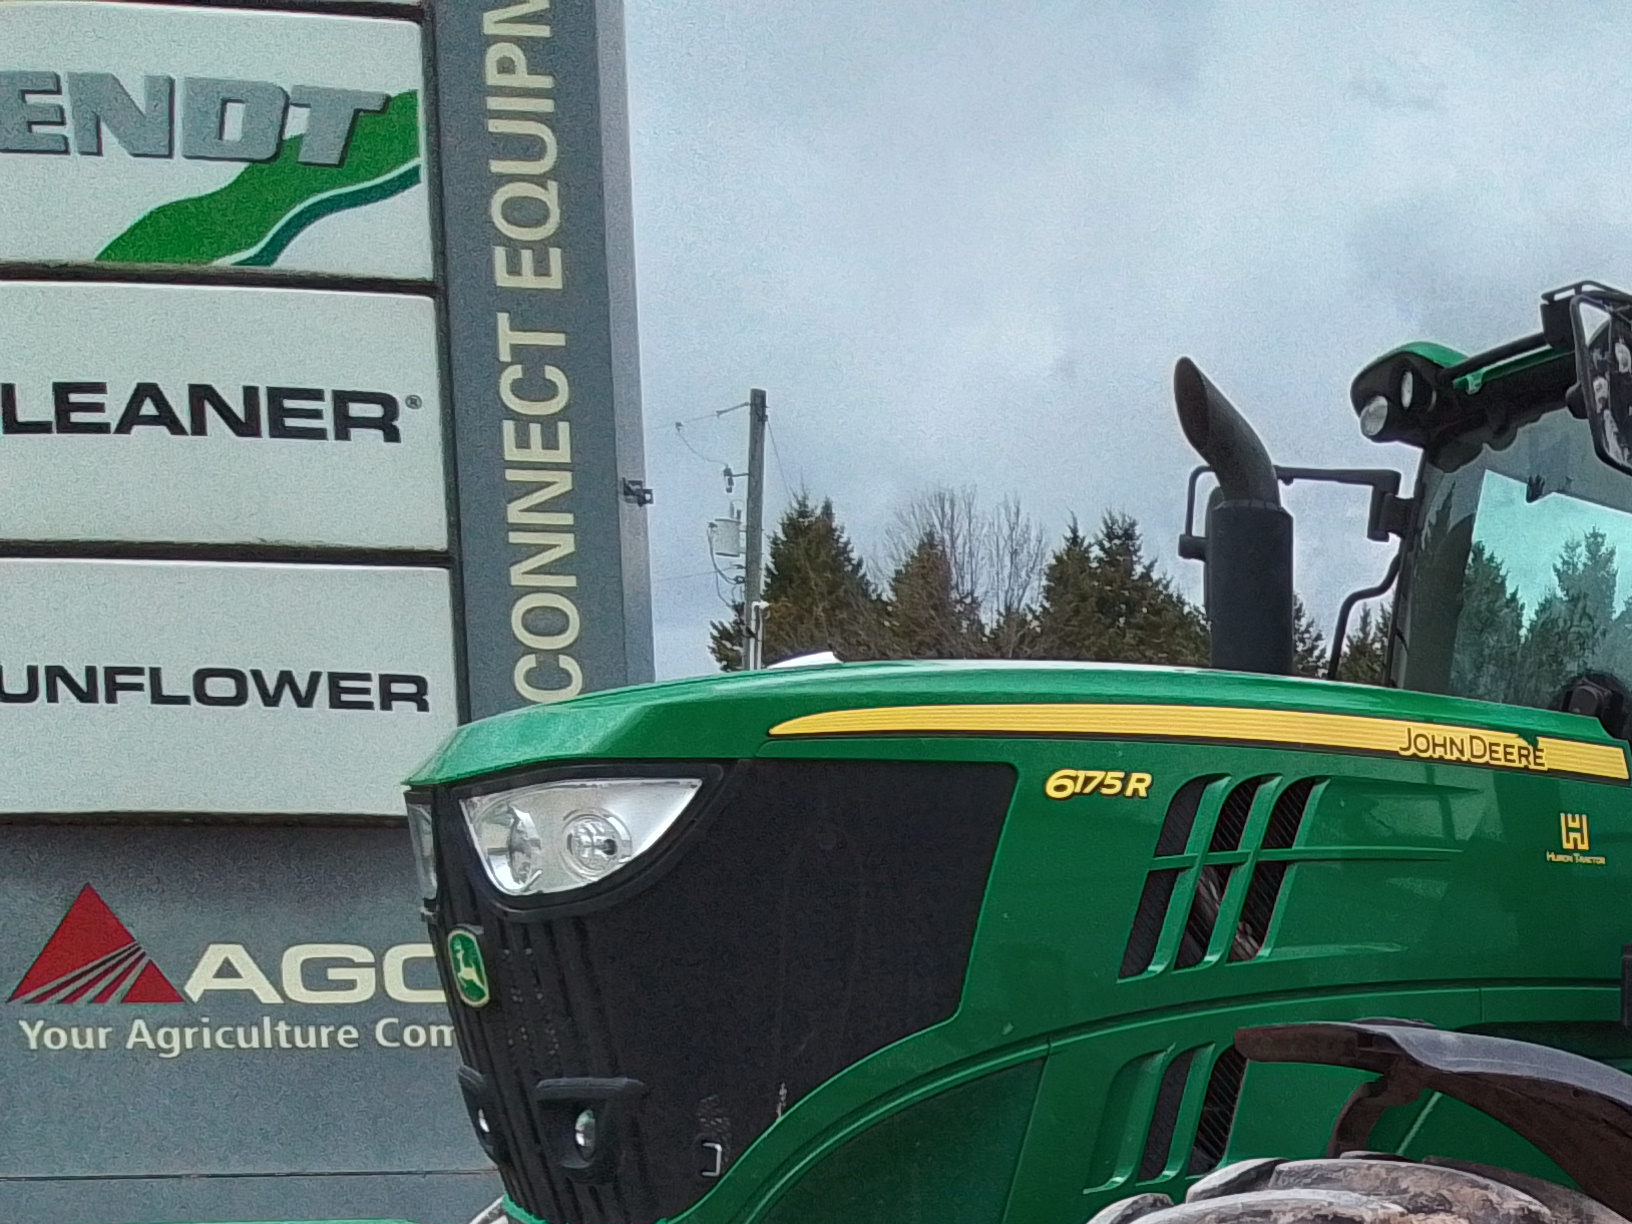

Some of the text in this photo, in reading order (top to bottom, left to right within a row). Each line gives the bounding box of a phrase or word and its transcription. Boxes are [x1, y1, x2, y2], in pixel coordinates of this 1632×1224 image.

[1, 381, 402, 443] LEANER
[498, 311, 583, 703] CONNECT
[0, 665, 430, 713] UNFLOWER
[19, 1019, 113, 1051] Your
[126, 1016, 359, 1059] Agriculture
